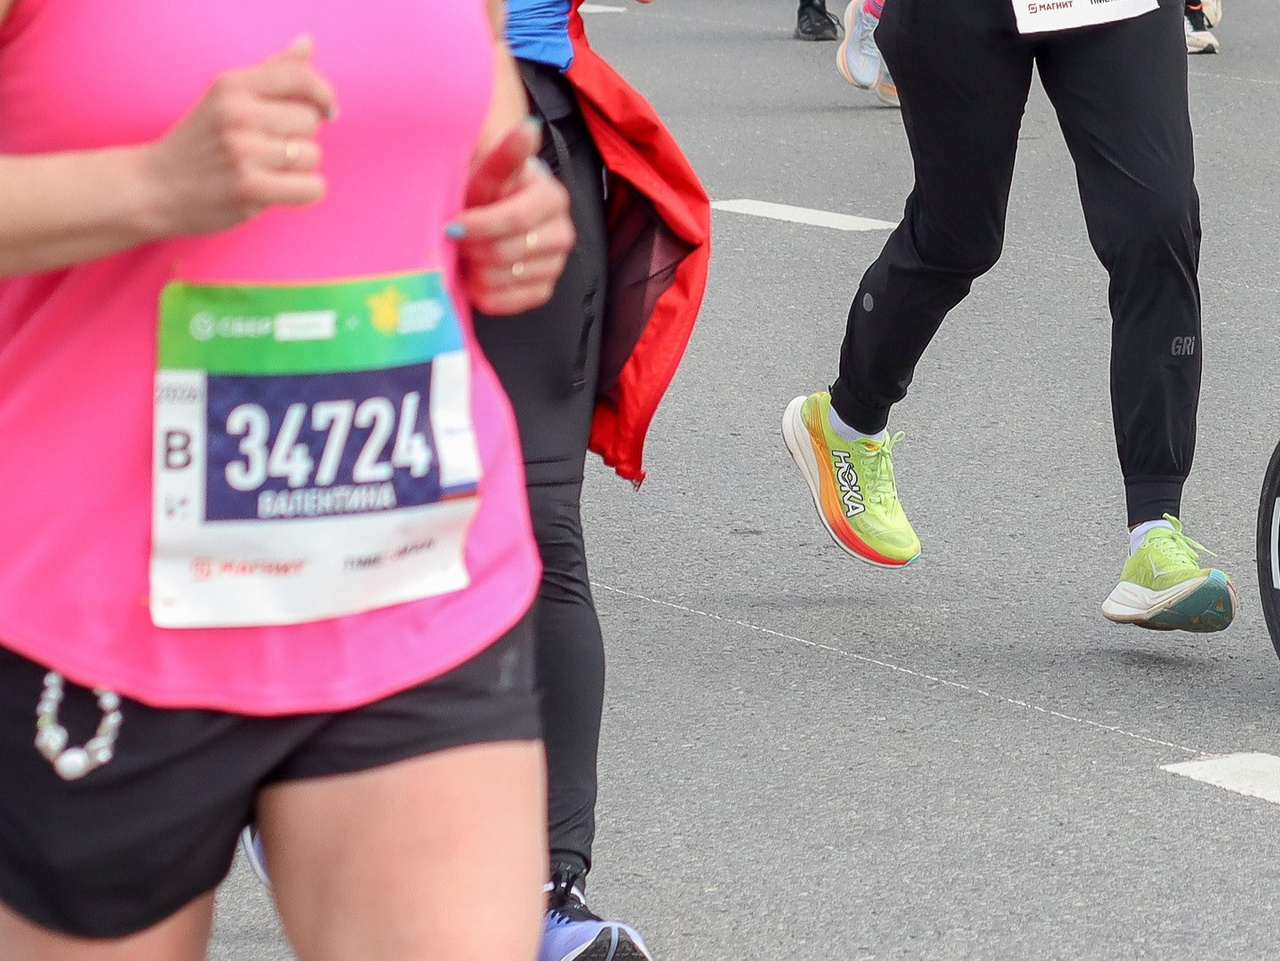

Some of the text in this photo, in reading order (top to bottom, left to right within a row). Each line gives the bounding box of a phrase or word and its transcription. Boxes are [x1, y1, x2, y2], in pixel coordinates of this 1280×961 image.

[1038, 0, 1074, 12] МАГНИТ
[225, 391, 434, 491] 34724
[257, 481, 398, 520] ВАЛЕНТИНА
[831, 450, 866, 518] HOKA
